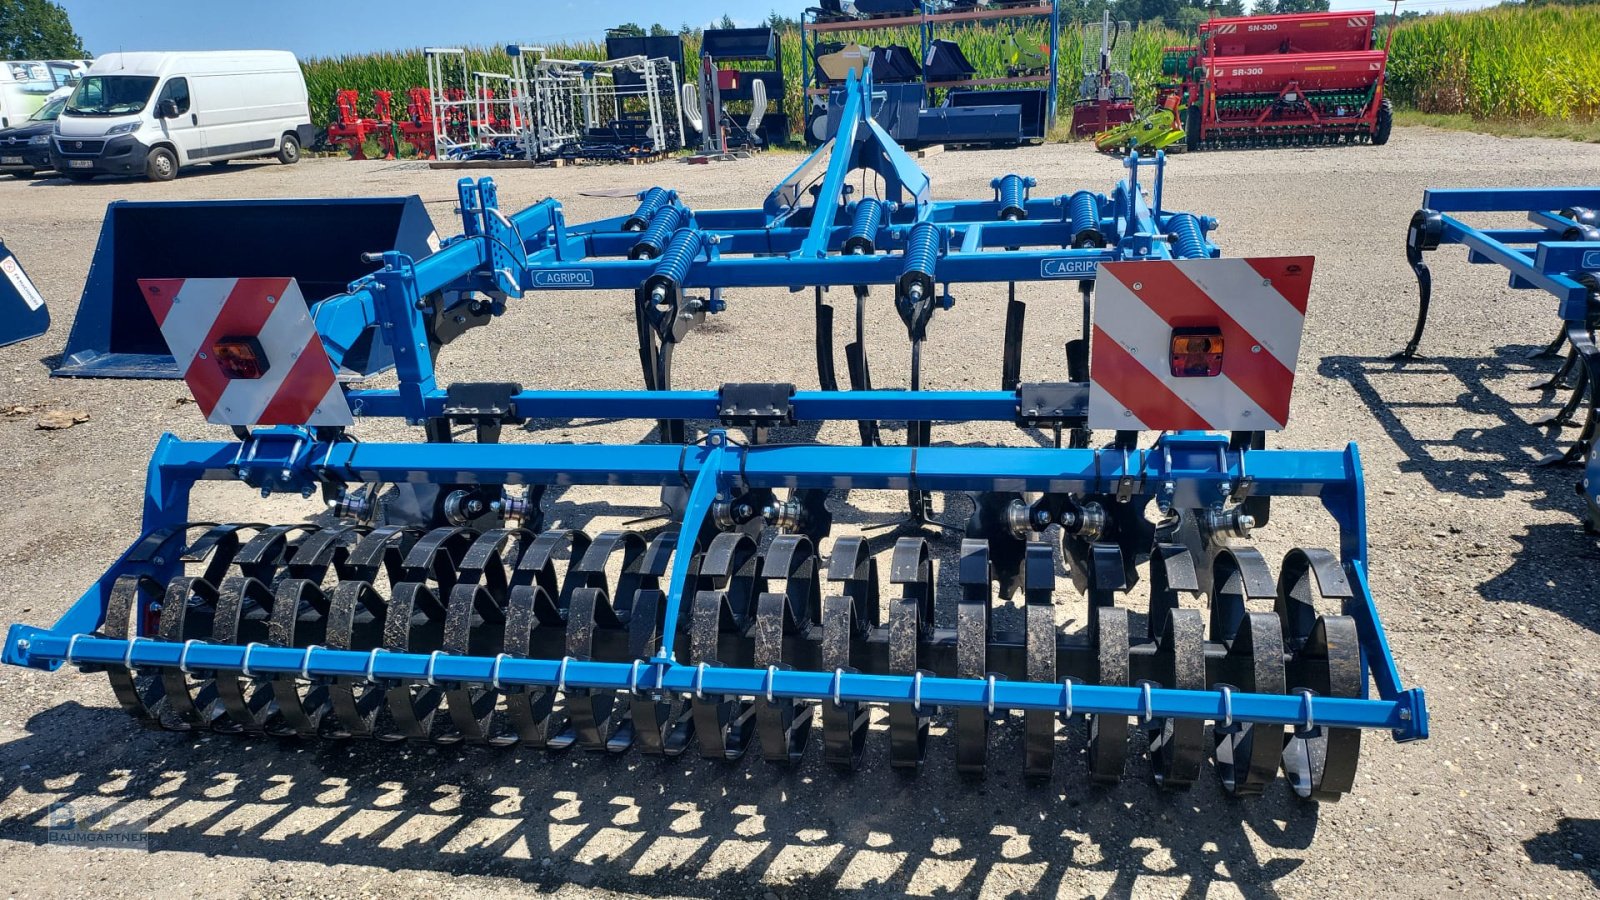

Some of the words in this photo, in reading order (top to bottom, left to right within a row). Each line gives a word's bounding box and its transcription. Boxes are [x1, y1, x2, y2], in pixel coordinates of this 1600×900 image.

[1247, 24, 1278, 32] SN-300
[1231, 68, 1263, 76] SR-300
[547, 272, 590, 283] AGRIPOL
